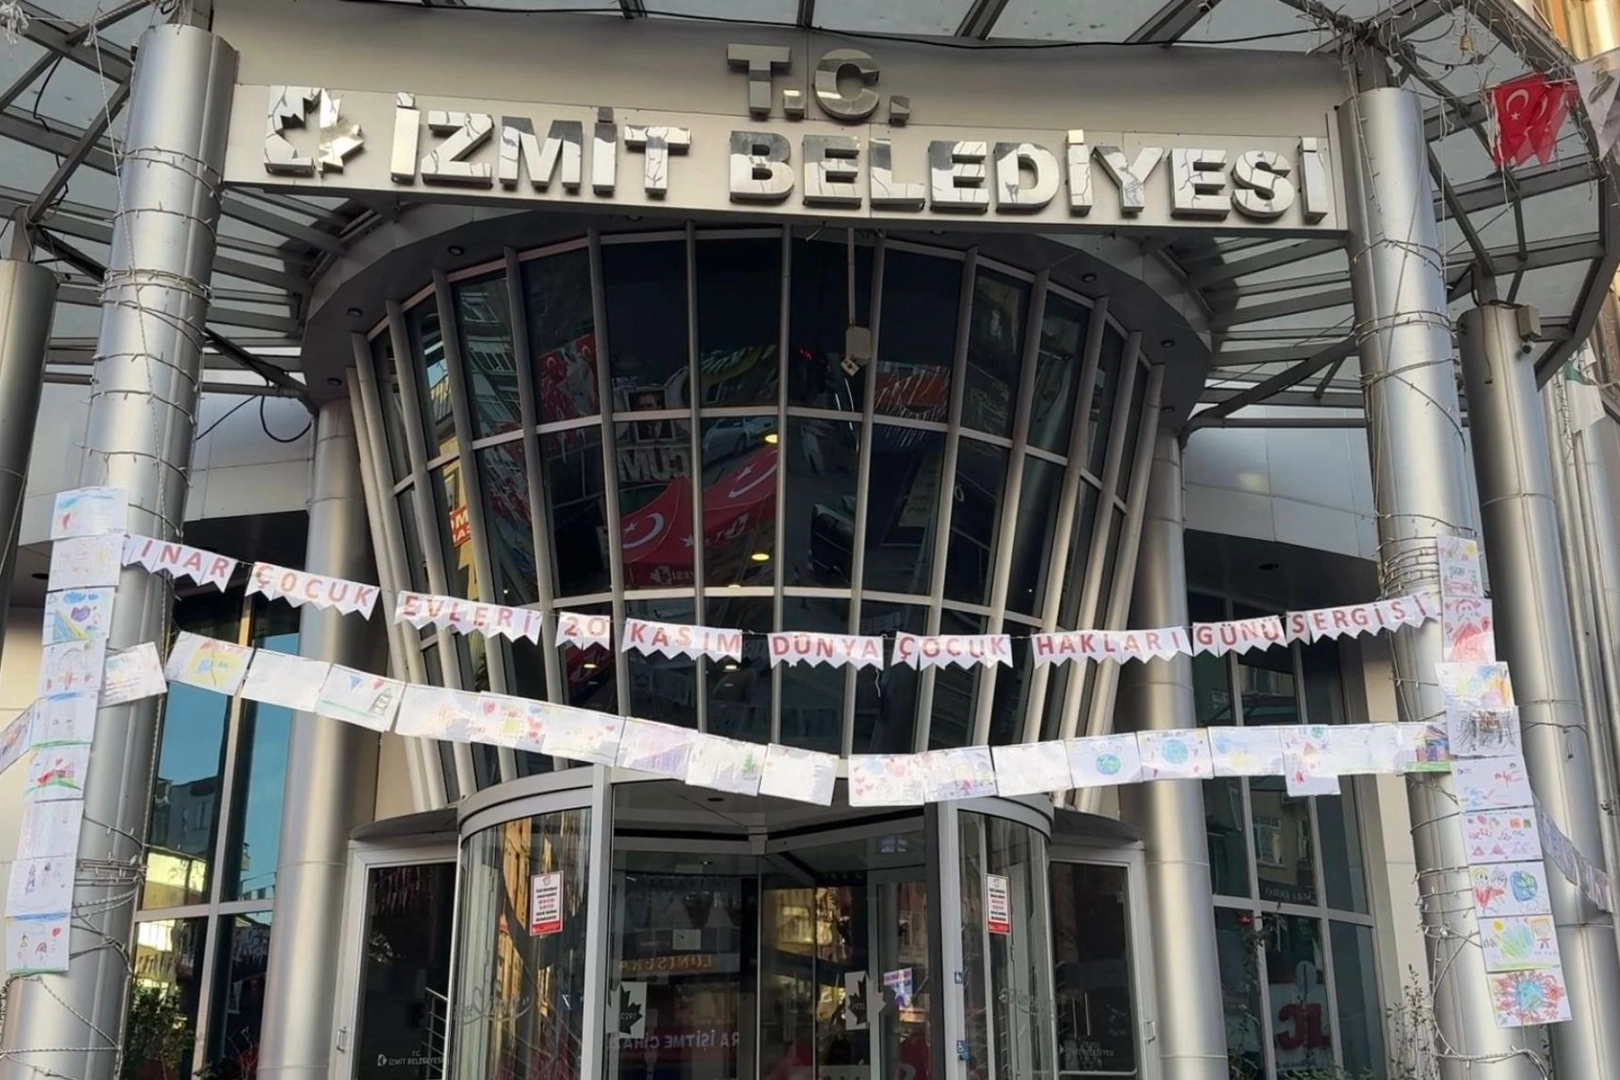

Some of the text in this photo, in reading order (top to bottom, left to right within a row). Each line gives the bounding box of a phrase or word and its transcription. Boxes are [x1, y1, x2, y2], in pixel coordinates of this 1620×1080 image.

[727, 43, 911, 126] T.C.
[390, 92, 1329, 224] İZMİT BELEDİYESİ
[252, 564, 373, 607] ÇOCUK
[402, 594, 533, 637] EVLERİ
[629, 621, 743, 655] KASIM
[772, 634, 879, 659] DÜNYA
[898, 634, 1008, 661] ÇOCUK
[1036, 630, 1180, 655] HAKLARI
[1195, 616, 1281, 648] GÜNÜ
[1291, 593, 1429, 636] SERGİSİ
